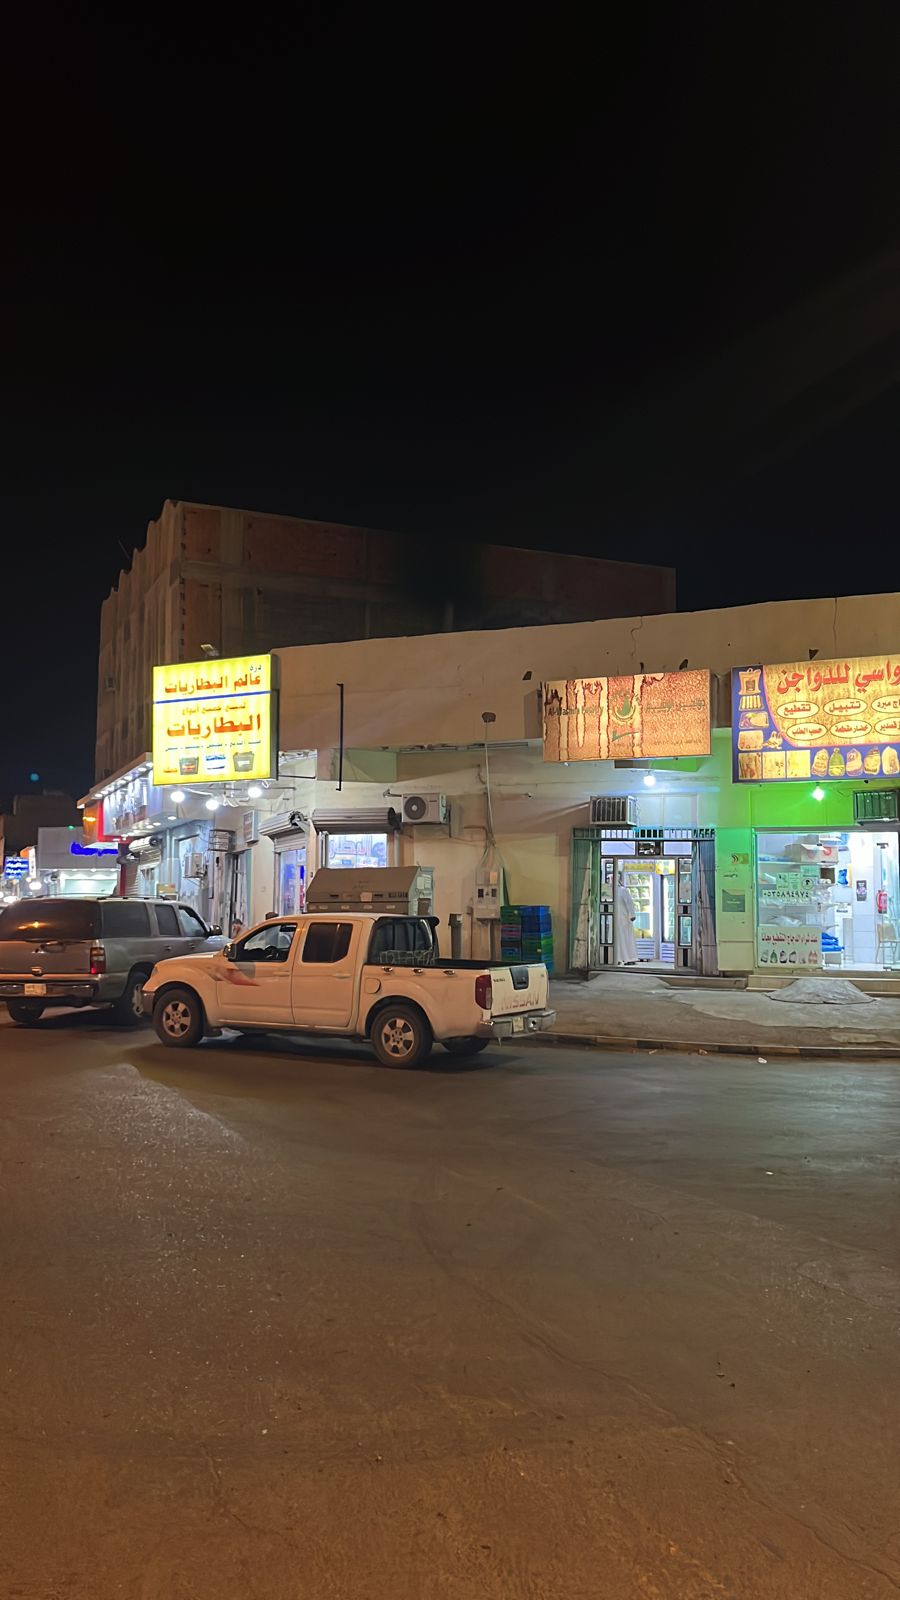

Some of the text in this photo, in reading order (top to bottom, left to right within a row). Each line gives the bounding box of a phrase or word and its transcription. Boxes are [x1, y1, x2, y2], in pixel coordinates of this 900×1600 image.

[165, 673, 261, 695] عالم البطاريات
[776, 662, 850, 694] للدواجن
[783, 703, 812, 716] تقطيع
[829, 701, 861, 713] تتبيل
[167, 713, 261, 740] البطاريات
